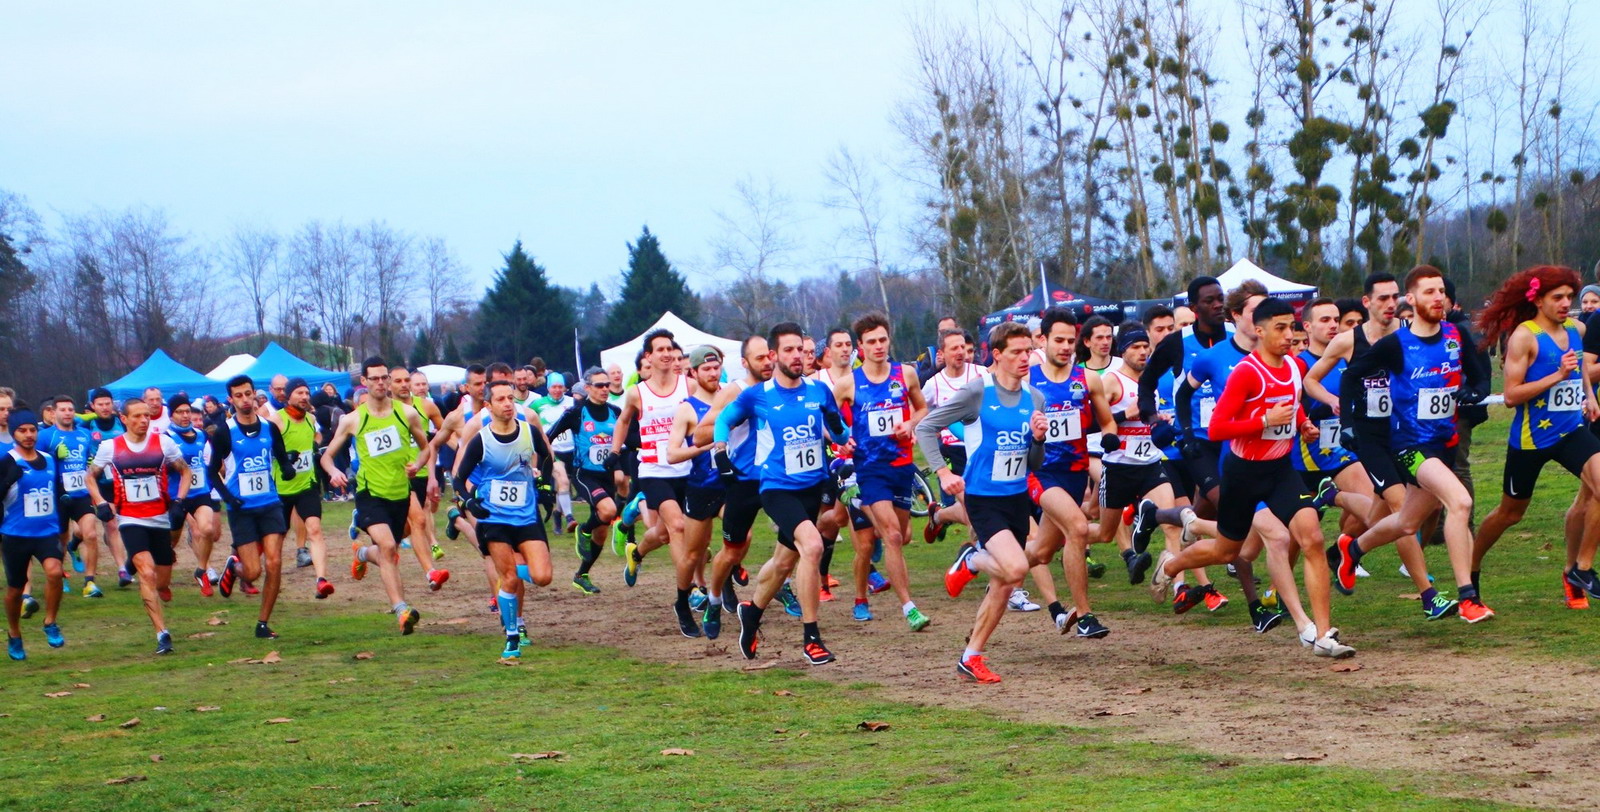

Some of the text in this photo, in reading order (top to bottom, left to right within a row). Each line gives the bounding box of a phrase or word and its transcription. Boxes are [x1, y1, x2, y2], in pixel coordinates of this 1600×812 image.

[1378, 395, 1389, 413] 6
[1429, 394, 1451, 415] 89
[782, 414, 816, 442] asl
[877, 414, 894, 432] 91
[1049, 418, 1069, 438] 81
[373, 433, 393, 451] 29
[996, 421, 1029, 446] asl
[596, 448, 609, 462] 68
[796, 448, 815, 468] 16
[1134, 441, 1152, 457] 42
[242, 447, 268, 470] asl
[296, 455, 309, 470] 24
[1004, 457, 1023, 477] 17
[71, 474, 83, 488] 20
[247, 476, 263, 492] 18
[133, 483, 150, 498] 71
[499, 486, 518, 503] 58
[33, 498, 49, 513] 15
